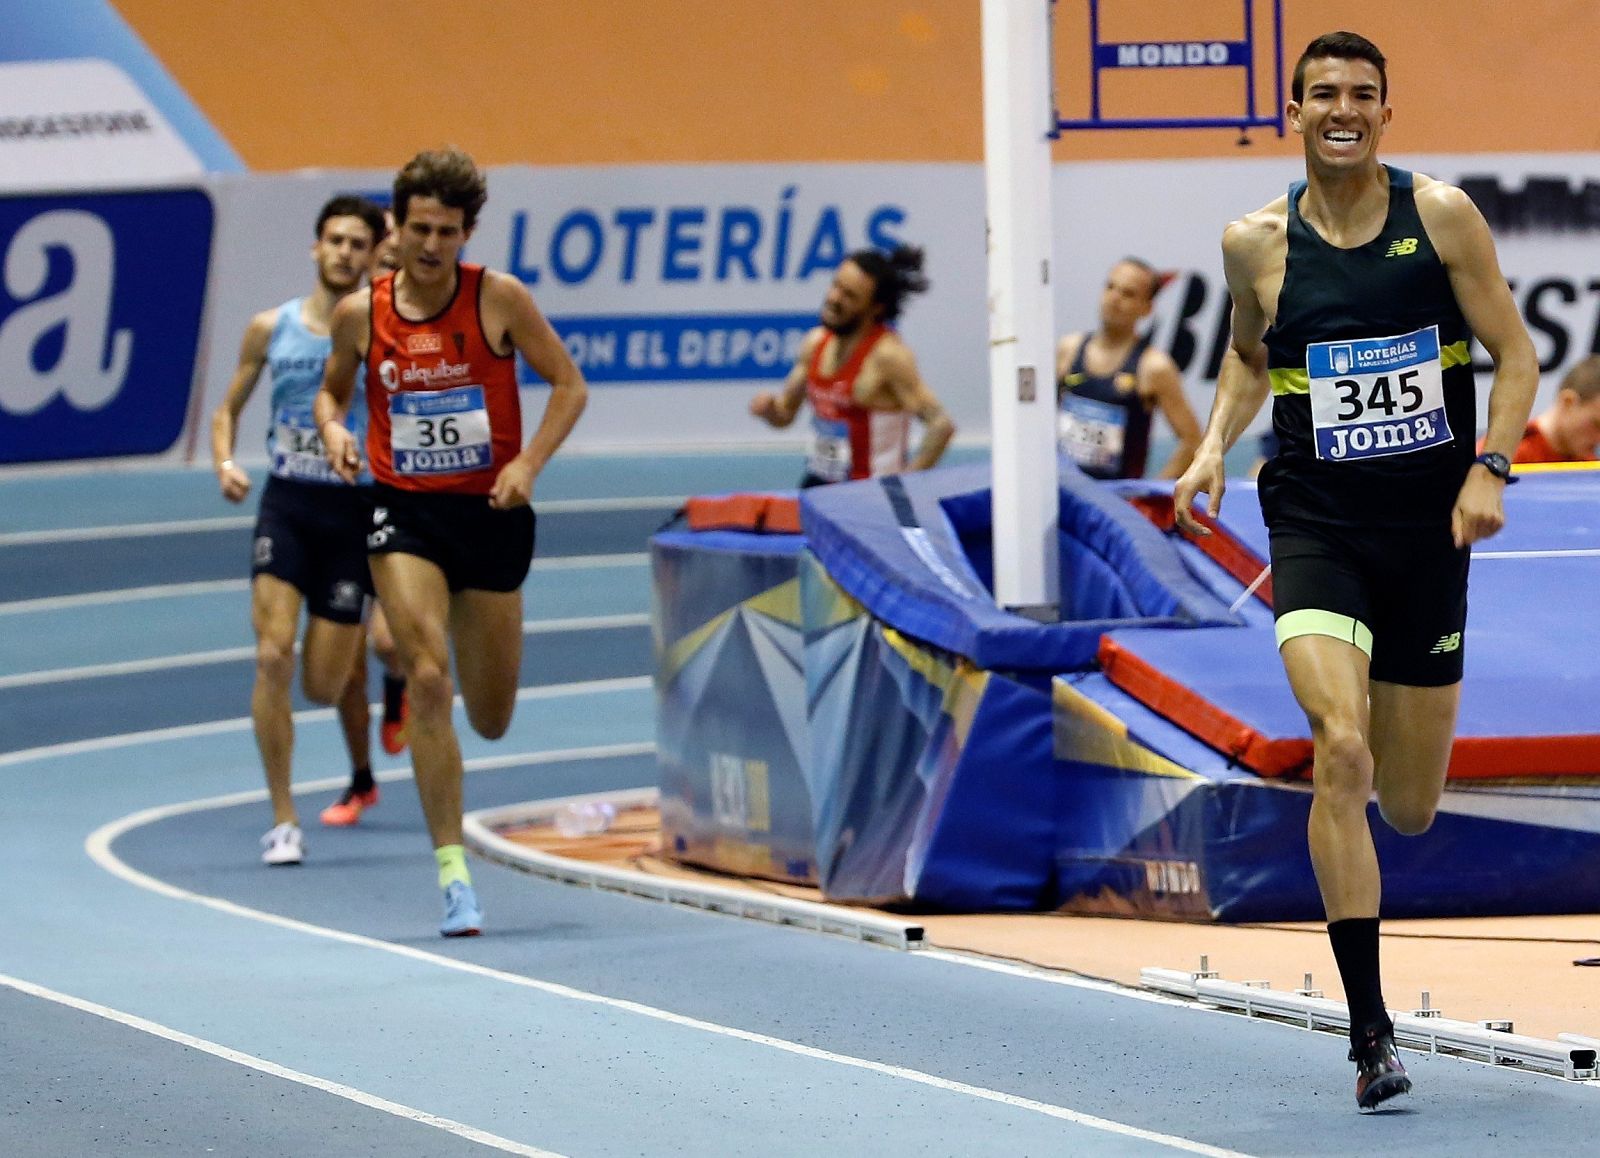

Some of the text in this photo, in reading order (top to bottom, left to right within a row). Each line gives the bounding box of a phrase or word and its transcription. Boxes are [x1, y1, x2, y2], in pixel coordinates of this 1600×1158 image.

[1117, 42, 1229, 66] MONDO
[507, 184, 907, 286] LOTERÍAS
[627, 328, 669, 370] EL
[1357, 341, 1416, 360] LOTERÍAS
[402, 358, 471, 386] alquiber
[1334, 369, 1424, 422] 345
[416, 416, 460, 447] 36
[400, 446, 481, 474] Joma
